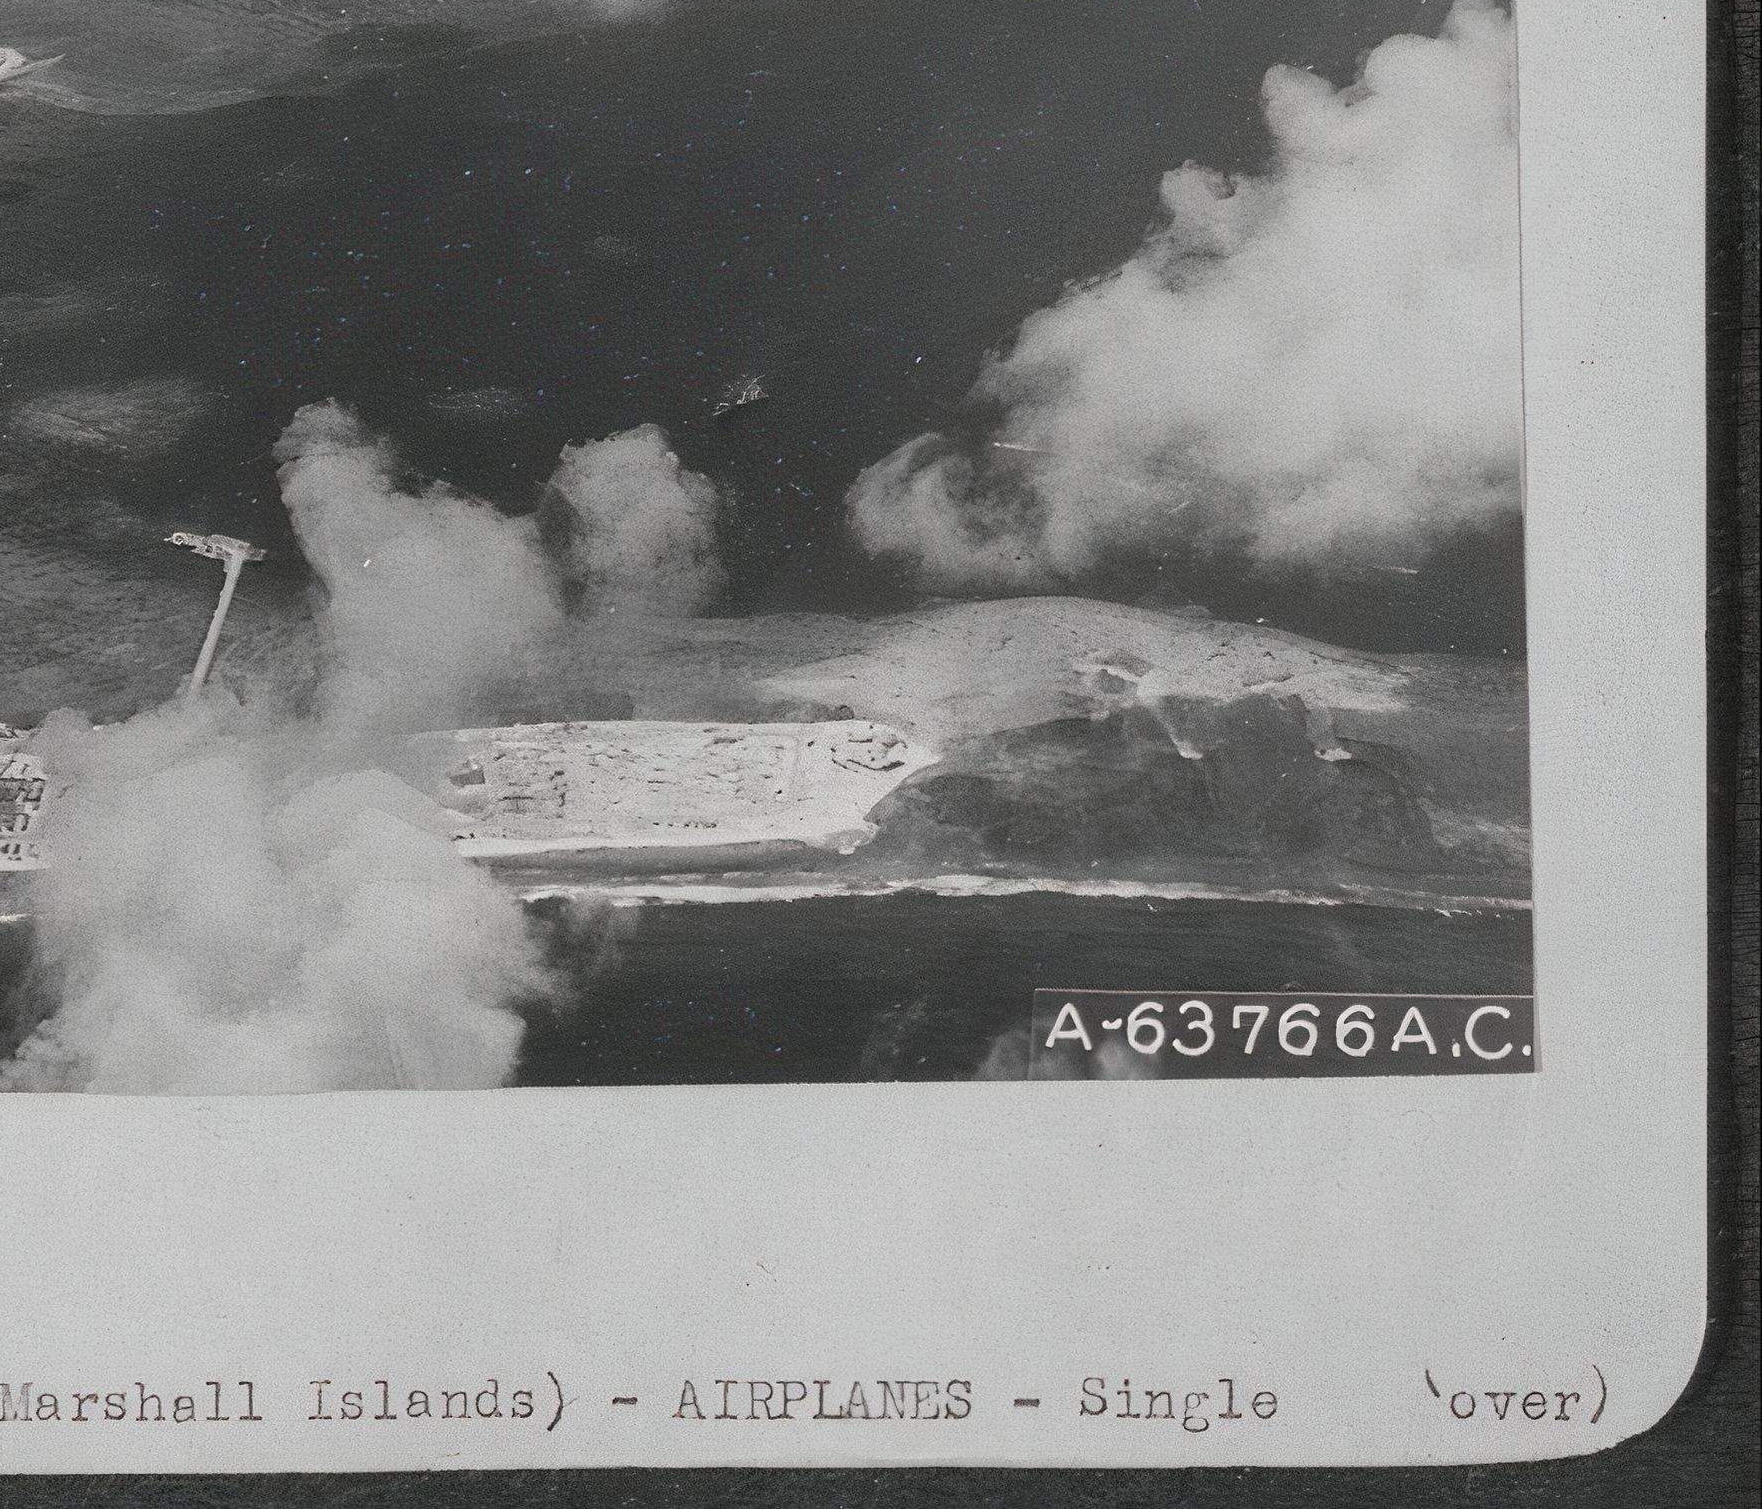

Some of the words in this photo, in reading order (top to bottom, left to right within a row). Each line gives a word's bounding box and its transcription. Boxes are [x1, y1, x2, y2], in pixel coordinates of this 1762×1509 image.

[308, 1371, 566, 1432] Islands)
[672, 1379, 973, 1421] AIRPLANES
[1079, 1377, 1279, 1434] Single
